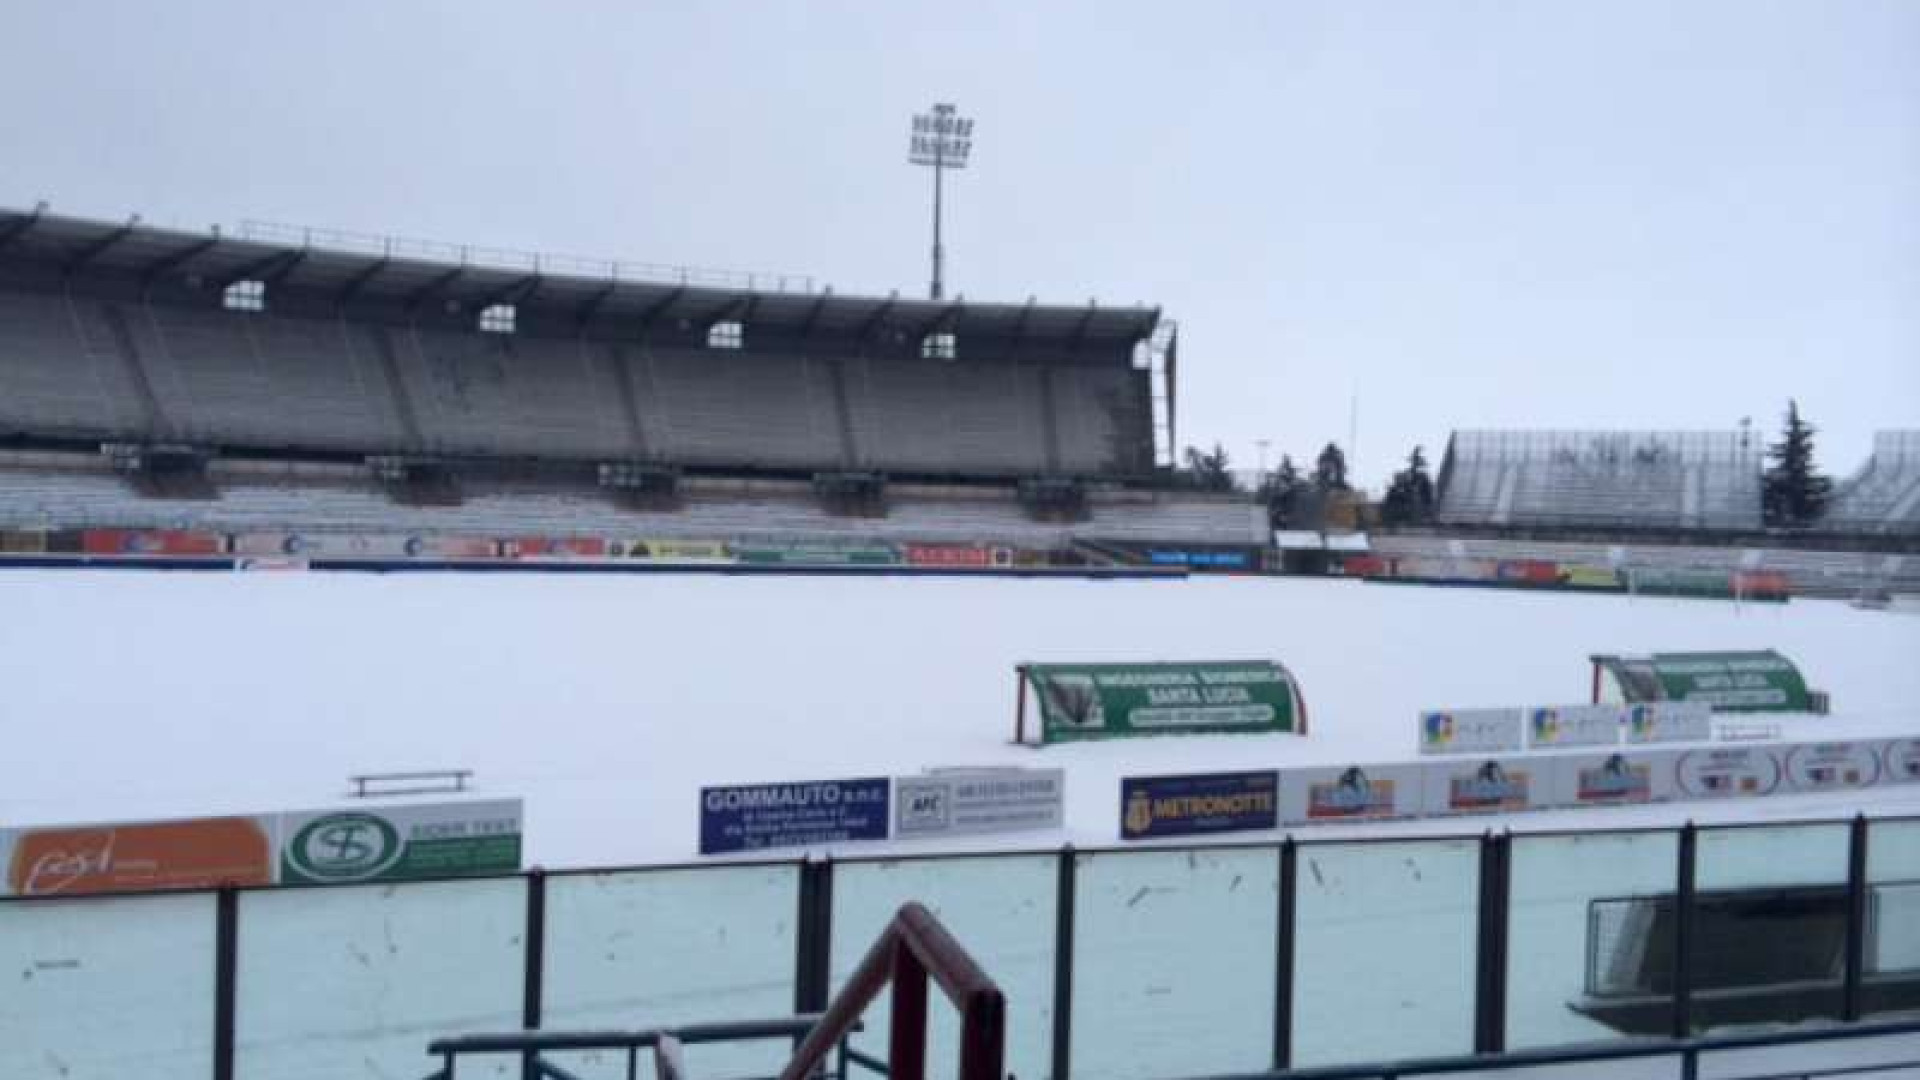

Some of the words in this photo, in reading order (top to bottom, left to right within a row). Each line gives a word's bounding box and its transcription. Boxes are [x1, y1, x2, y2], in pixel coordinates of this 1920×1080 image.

[1148, 685, 1200, 703] SANTA
[1202, 684, 1250, 703] LUCIA
[706, 783, 841, 813] GOMMAUTO
[1153, 792, 1273, 819] METRONOTTE
